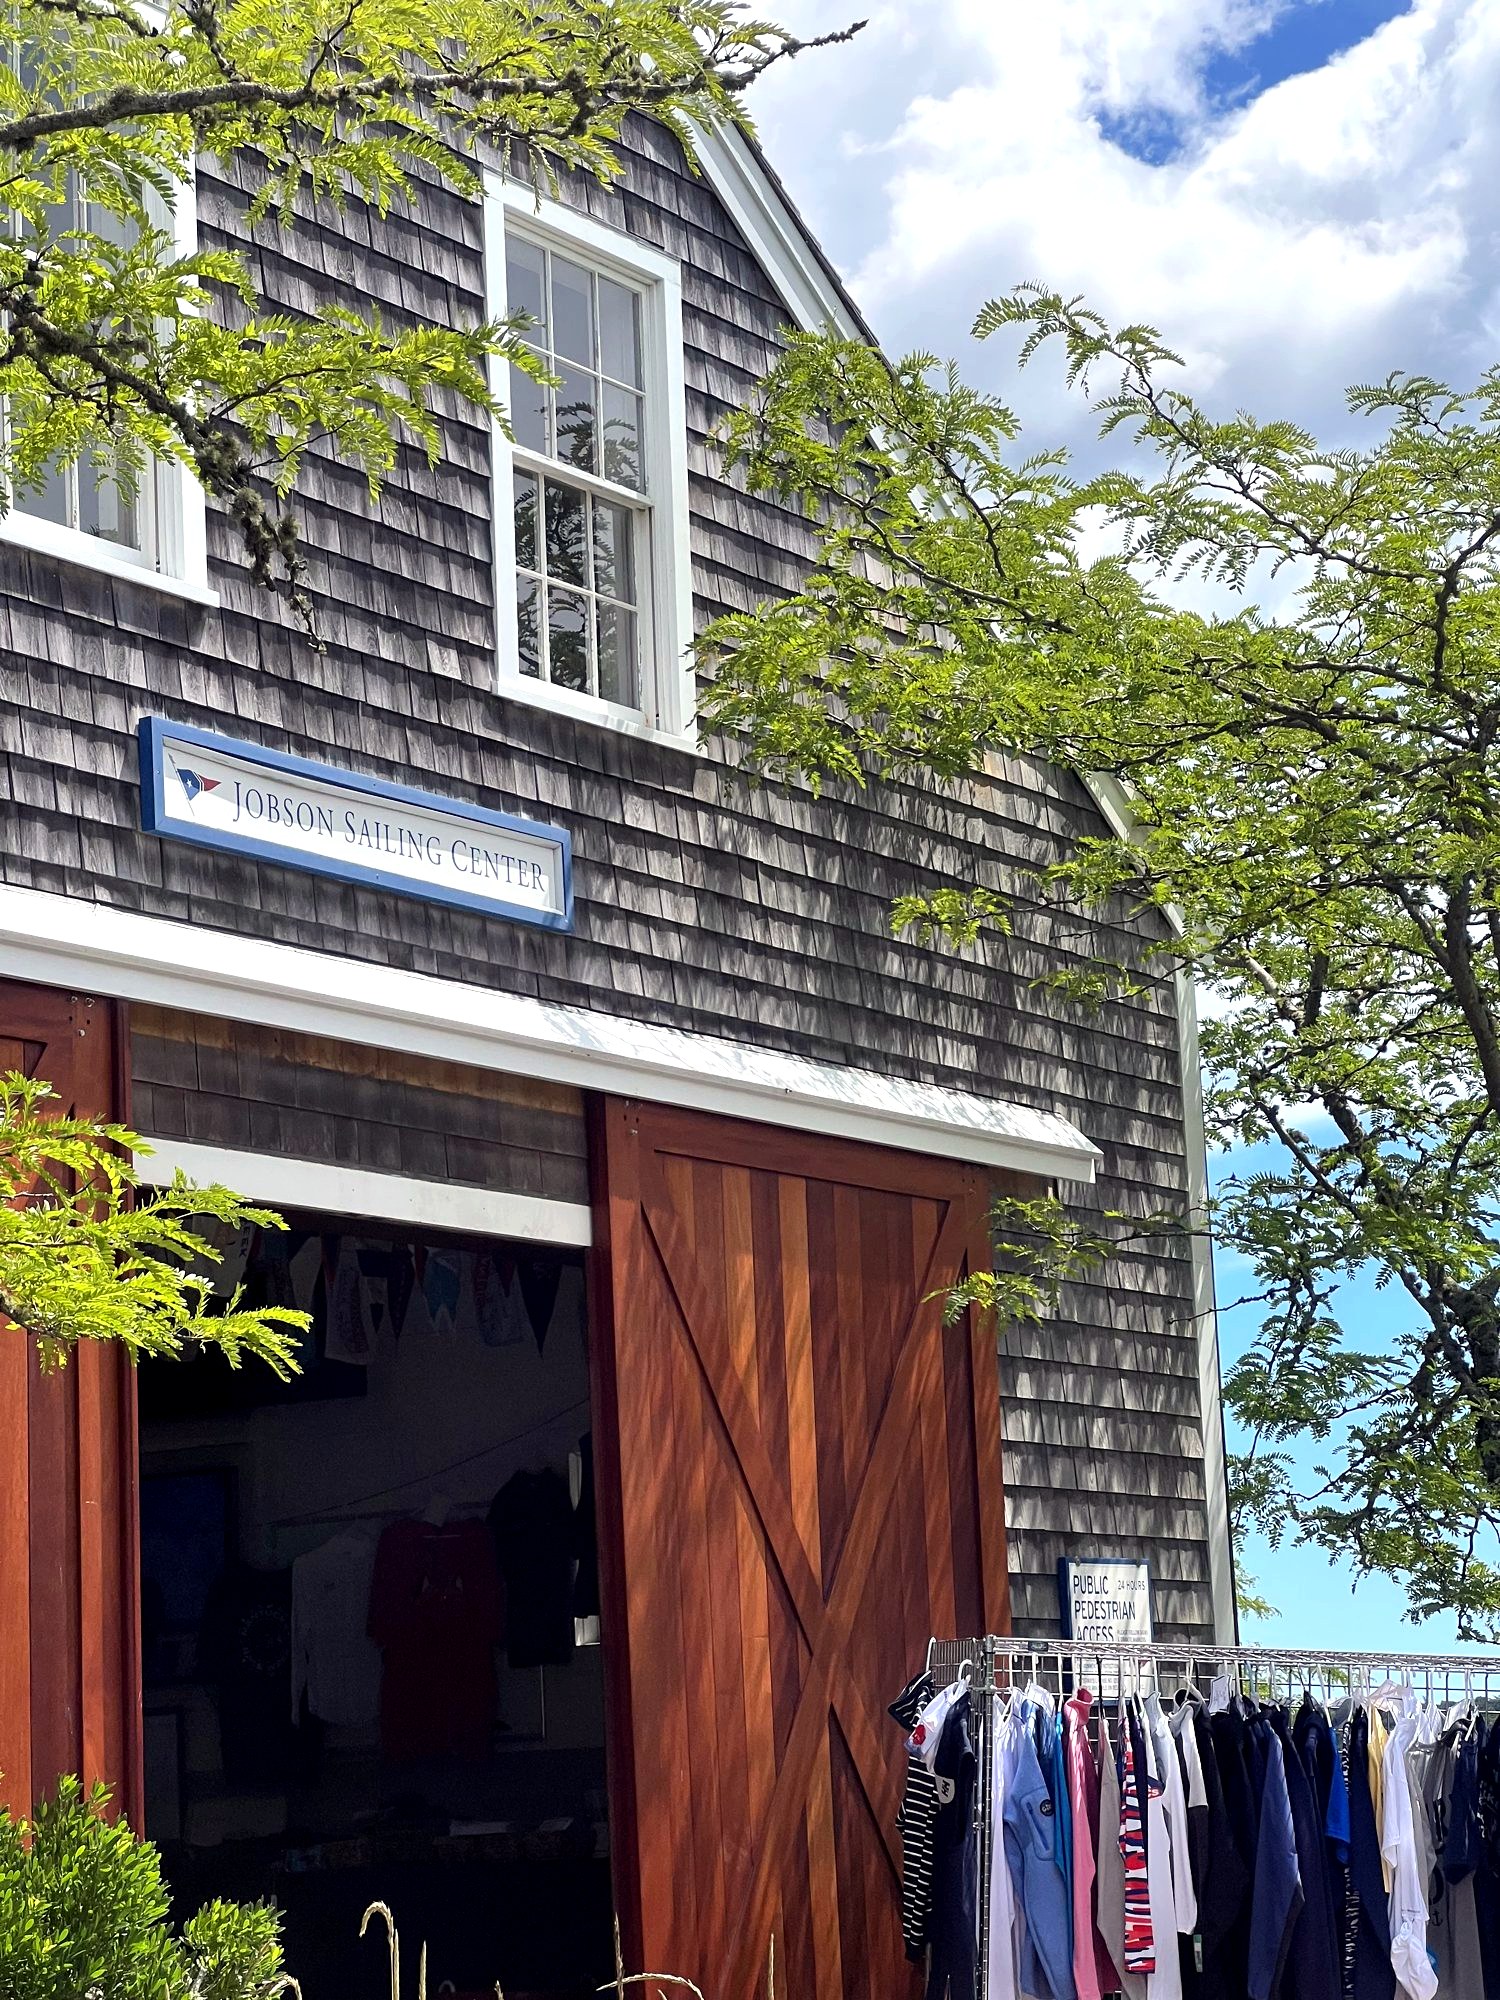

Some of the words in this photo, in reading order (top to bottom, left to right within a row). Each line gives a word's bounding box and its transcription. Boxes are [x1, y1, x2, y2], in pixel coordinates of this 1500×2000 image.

[232, 780, 334, 838] JOBSON
[344, 810, 442, 867] SAILING
[451, 839, 546, 893] CENTER
[1073, 1575, 1109, 1595] PUBLIC
[1074, 1600, 1136, 1620] PEDESTRIAN
[1076, 1626, 1114, 1641] ACCESS
